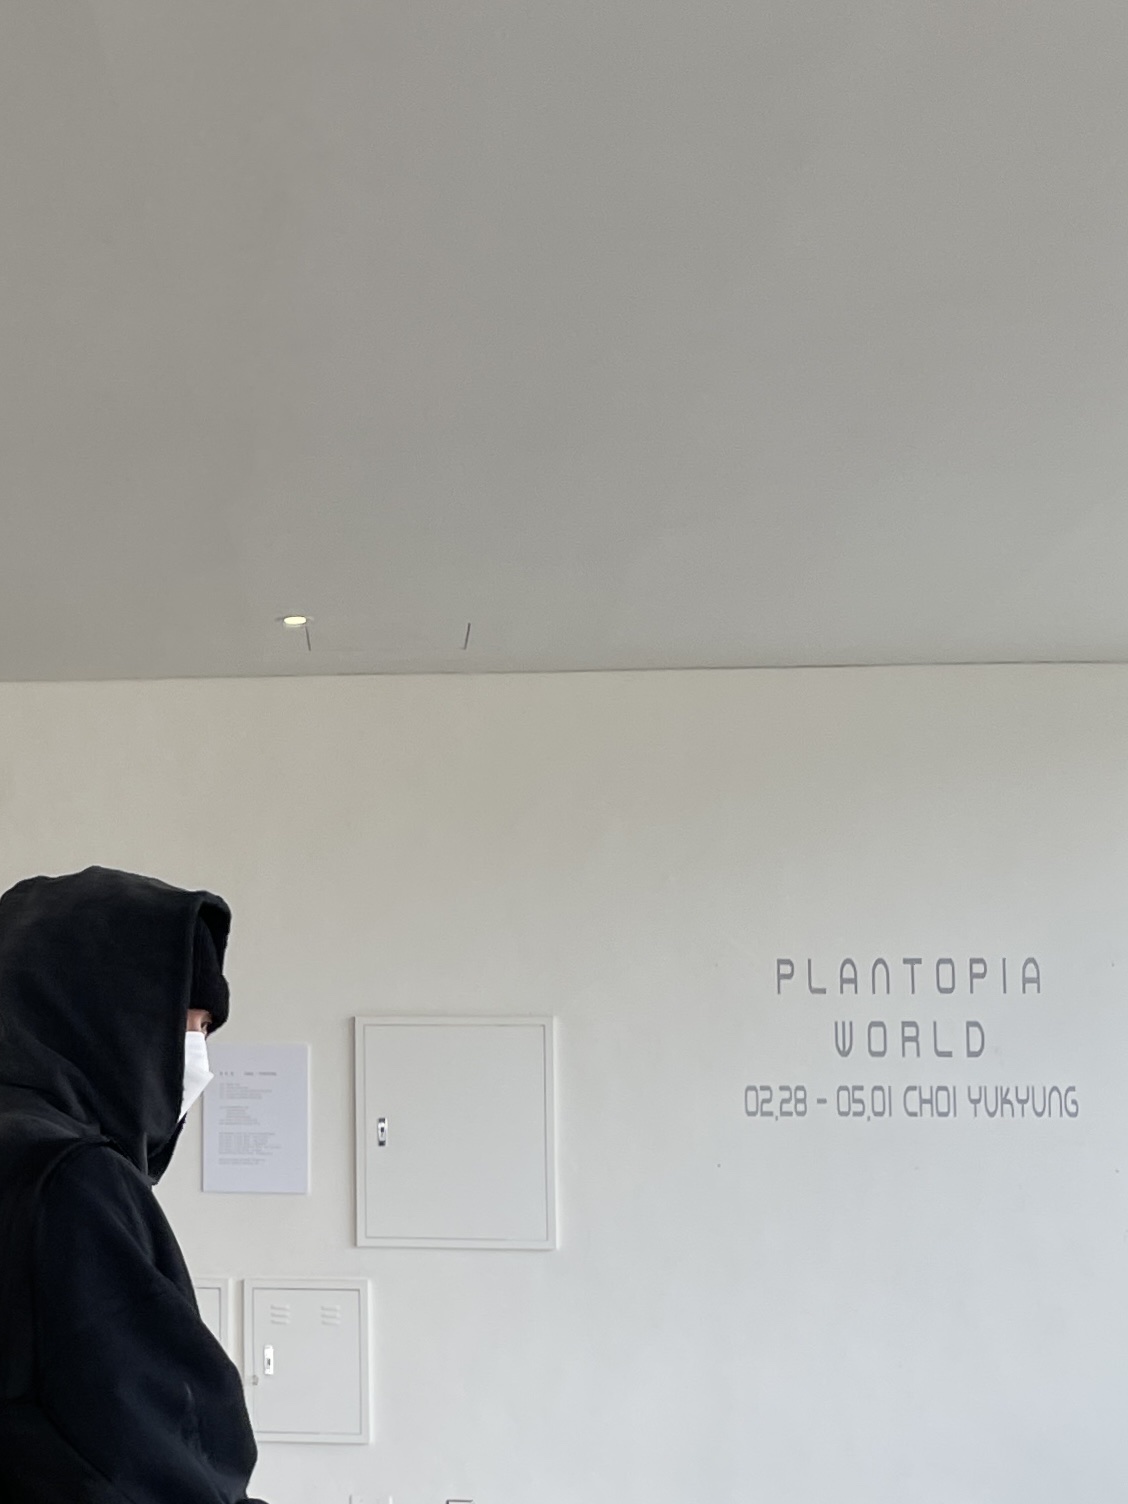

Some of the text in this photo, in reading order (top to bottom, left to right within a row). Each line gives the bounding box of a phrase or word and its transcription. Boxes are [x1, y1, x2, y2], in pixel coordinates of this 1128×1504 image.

[776, 957, 1041, 995] PLANTOPIA
[833, 1020, 985, 1058] WORLD
[903, 1085, 957, 1118] CHOI
[967, 1085, 1080, 1118] YUKYUNG
